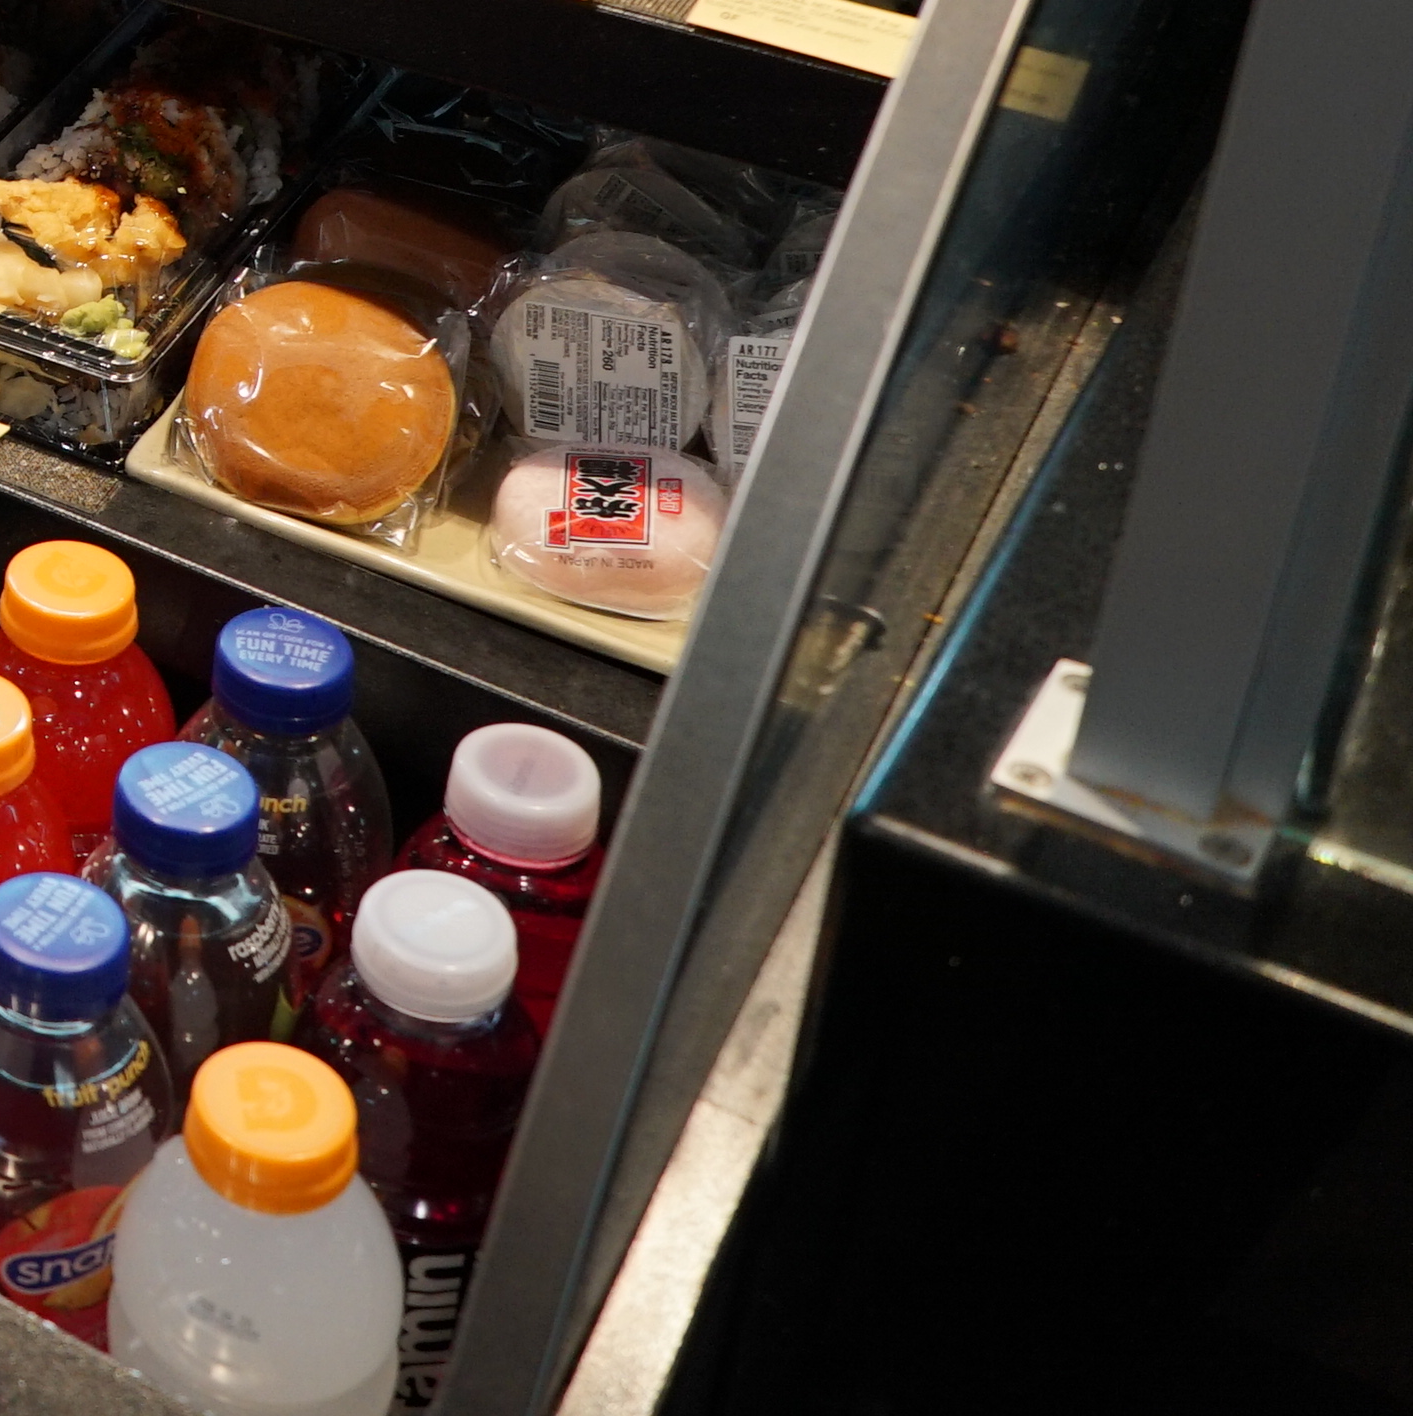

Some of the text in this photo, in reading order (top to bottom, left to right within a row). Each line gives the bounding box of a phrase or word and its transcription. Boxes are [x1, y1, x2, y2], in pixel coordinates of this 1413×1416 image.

[637, 325, 646, 352] Facts
[648, 326, 658, 369] Nutrition
[661, 331, 673, 364] AR 178
[602, 350, 614, 371] 260
[739, 344, 779, 357] AR 177
[736, 369, 768, 381] Facts
[737, 401, 765, 411] Calorie
[559, 554, 655, 570] MADE IN JAPAN
[236, 636, 332, 664] FUN TIME
[277, 634, 304, 644] CODE
[239, 649, 323, 673] EVERY TIME
[41, 1040, 151, 1109] fruit punch
